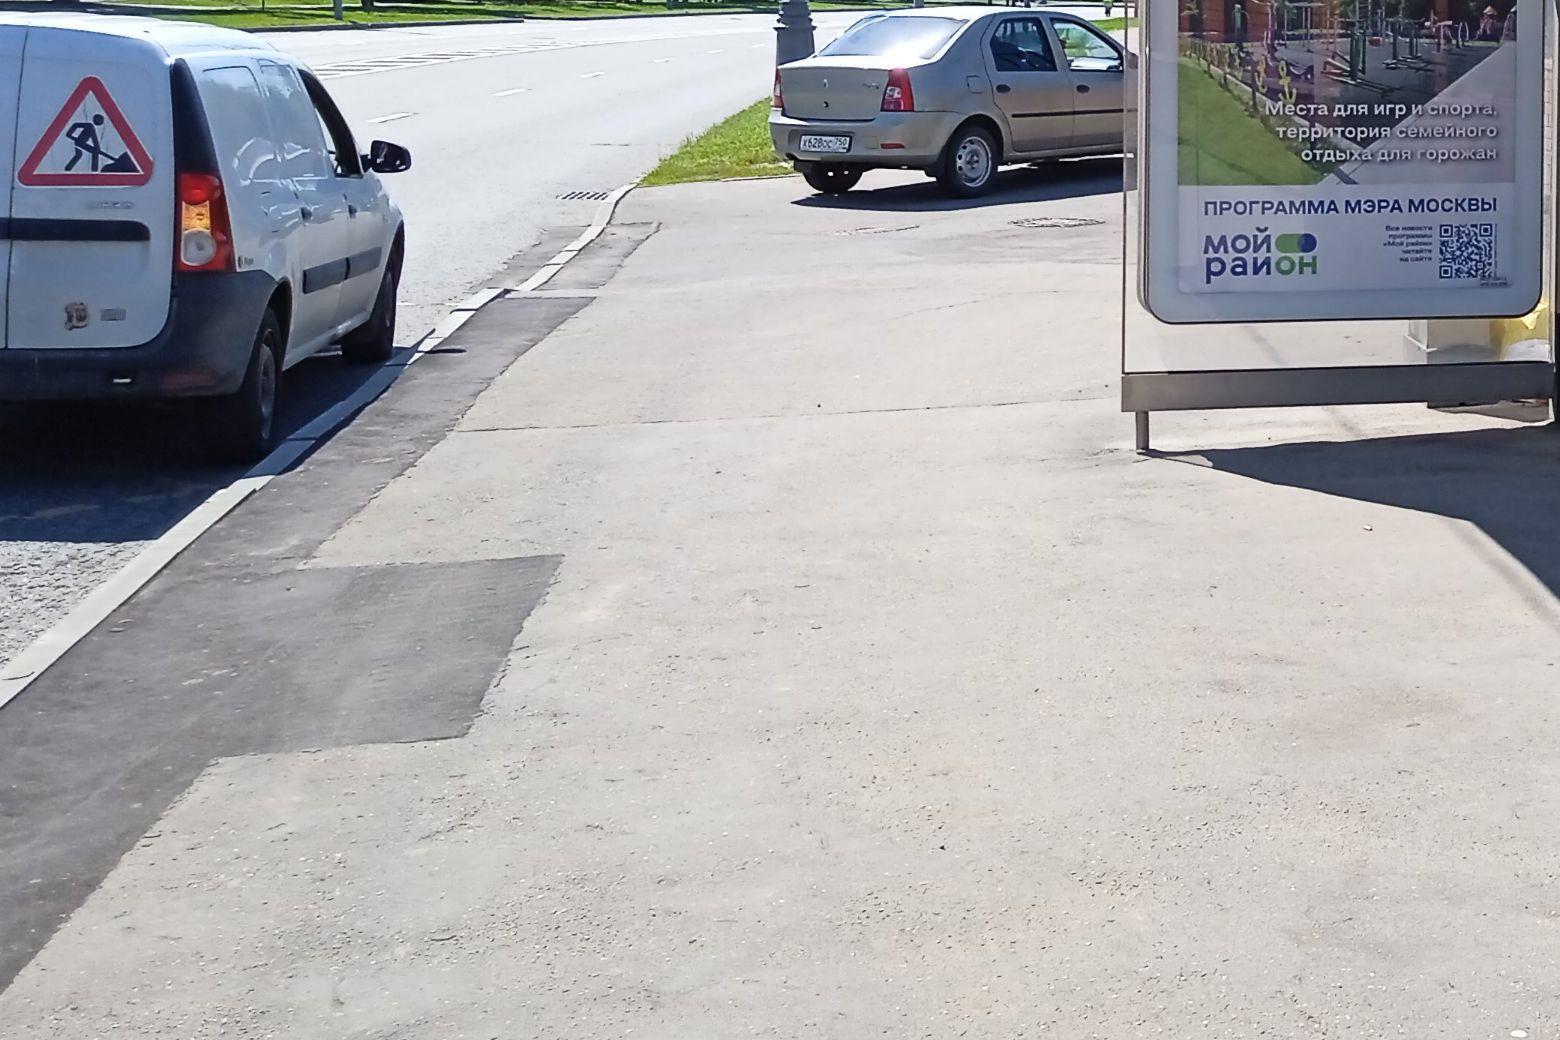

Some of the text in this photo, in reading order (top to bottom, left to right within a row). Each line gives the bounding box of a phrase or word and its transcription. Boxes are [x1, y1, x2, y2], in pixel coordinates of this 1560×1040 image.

[1265, 101, 1328, 116] Места
[1333, 104, 1369, 118] для
[1374, 104, 1406, 118] игр
[1412, 104, 1422, 115] и
[1276, 122, 1497, 141] территория семейного
[1301, 148, 1496, 163] отдыха для горожан
[1204, 197, 1497, 216] ПРОГРАММА МЭРА МОСКВЫ
[1203, 226, 1272, 254] мой
